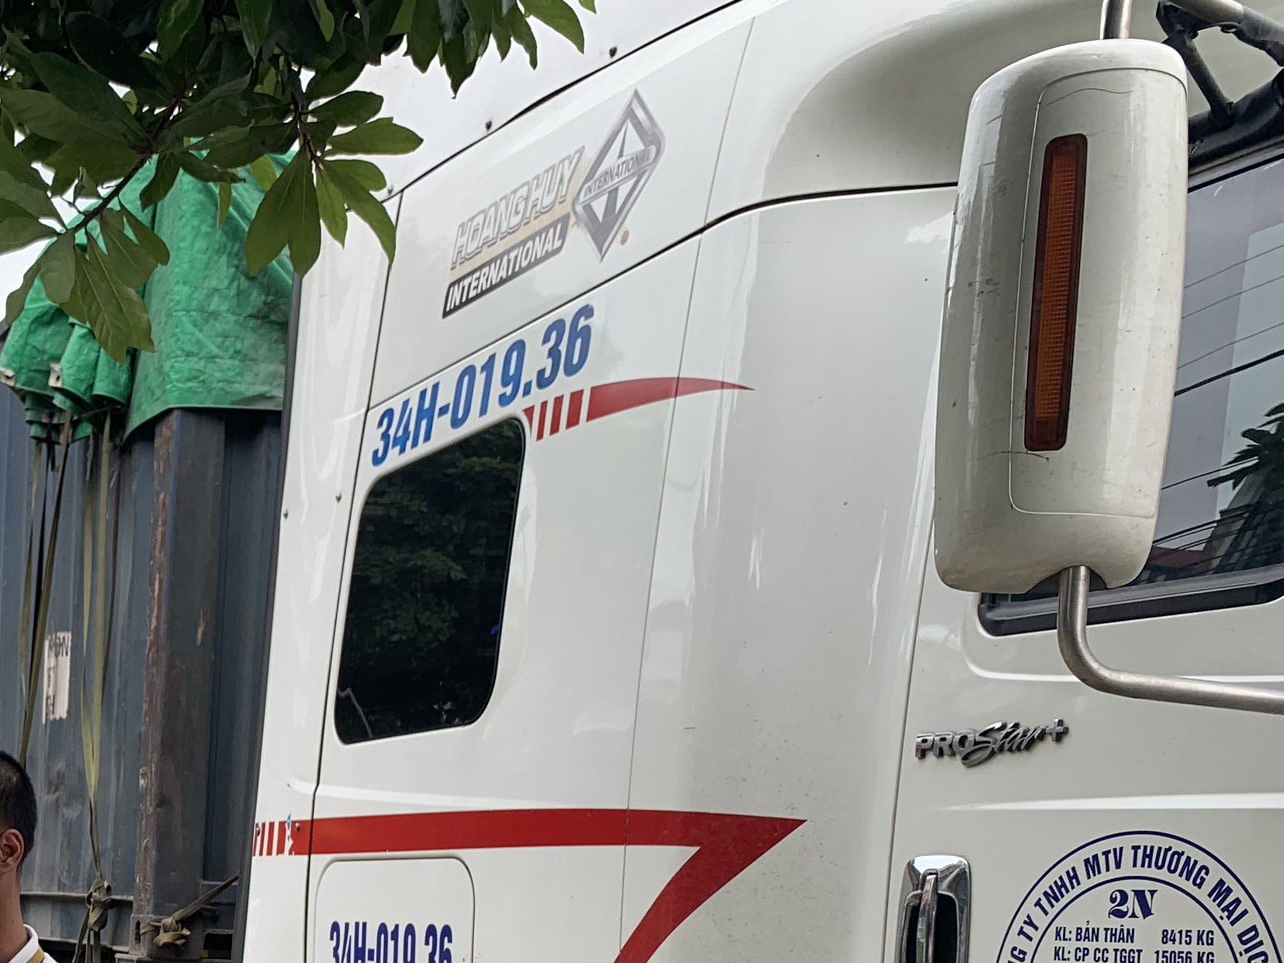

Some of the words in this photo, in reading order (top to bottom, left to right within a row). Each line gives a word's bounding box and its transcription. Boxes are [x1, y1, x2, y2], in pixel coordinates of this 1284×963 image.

[583, 150, 653, 198] INTERNATIONAL
[446, 221, 564, 312] INTERNATIONAL
[371, 304, 595, 467] 34H-019.36
[1017, 914, 1039, 942] TY
[1034, 866, 1081, 917] TNHH
[1083, 846, 1124, 880] MTV
[1131, 845, 1210, 890] THƯƠNG
[1207, 878, 1249, 927] MẠI
[1108, 889, 1158, 920] 2N
[1054, 946, 1071, 962] KL:
[1074, 947, 1090, 963] CP
[1093, 948, 1109, 963] CC
[1055, 926, 1072, 942] KL:
[1075, 920, 1100, 943] BẢN
[1103, 924, 1135, 943] THÂN
[1161, 929, 1193, 945] 8415
[1196, 930, 1215, 946] KG
